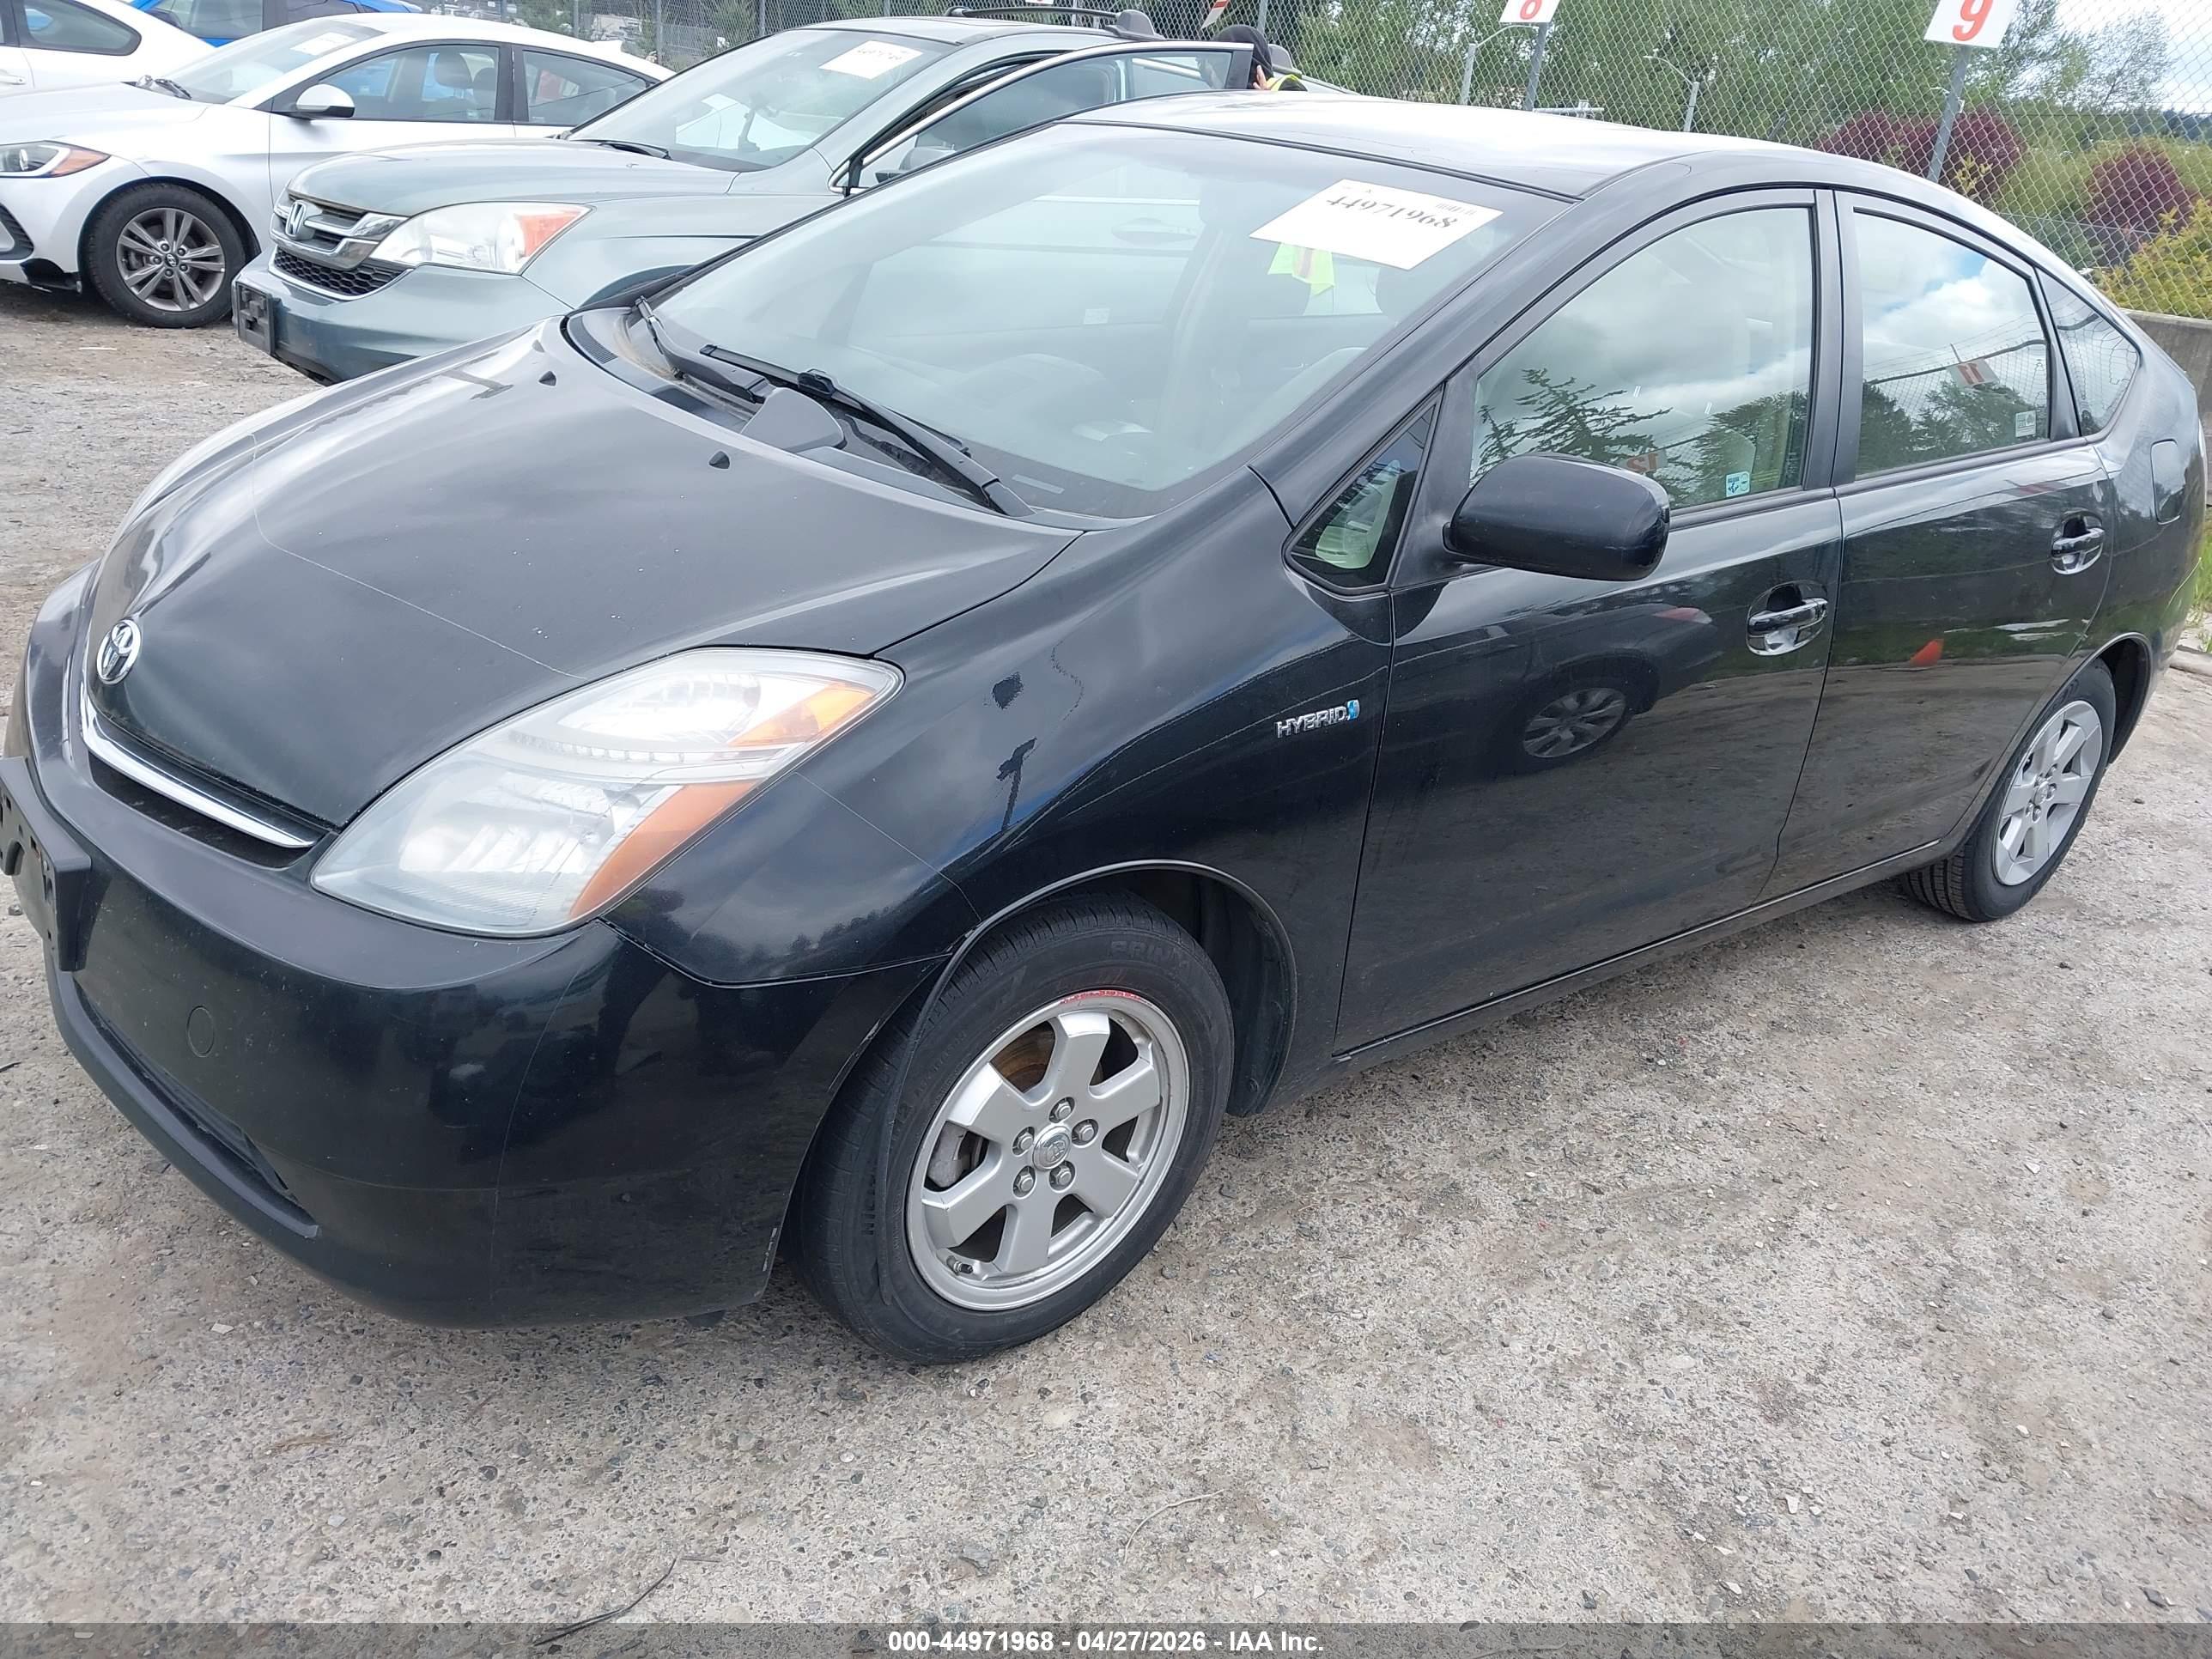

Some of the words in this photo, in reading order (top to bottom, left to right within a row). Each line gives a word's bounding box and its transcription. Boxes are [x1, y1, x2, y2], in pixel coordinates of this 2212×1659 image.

[1952, 0, 1993, 42] 9
[1327, 196, 1458, 228] 44971968
[1275, 705, 1348, 738] HYBRID
